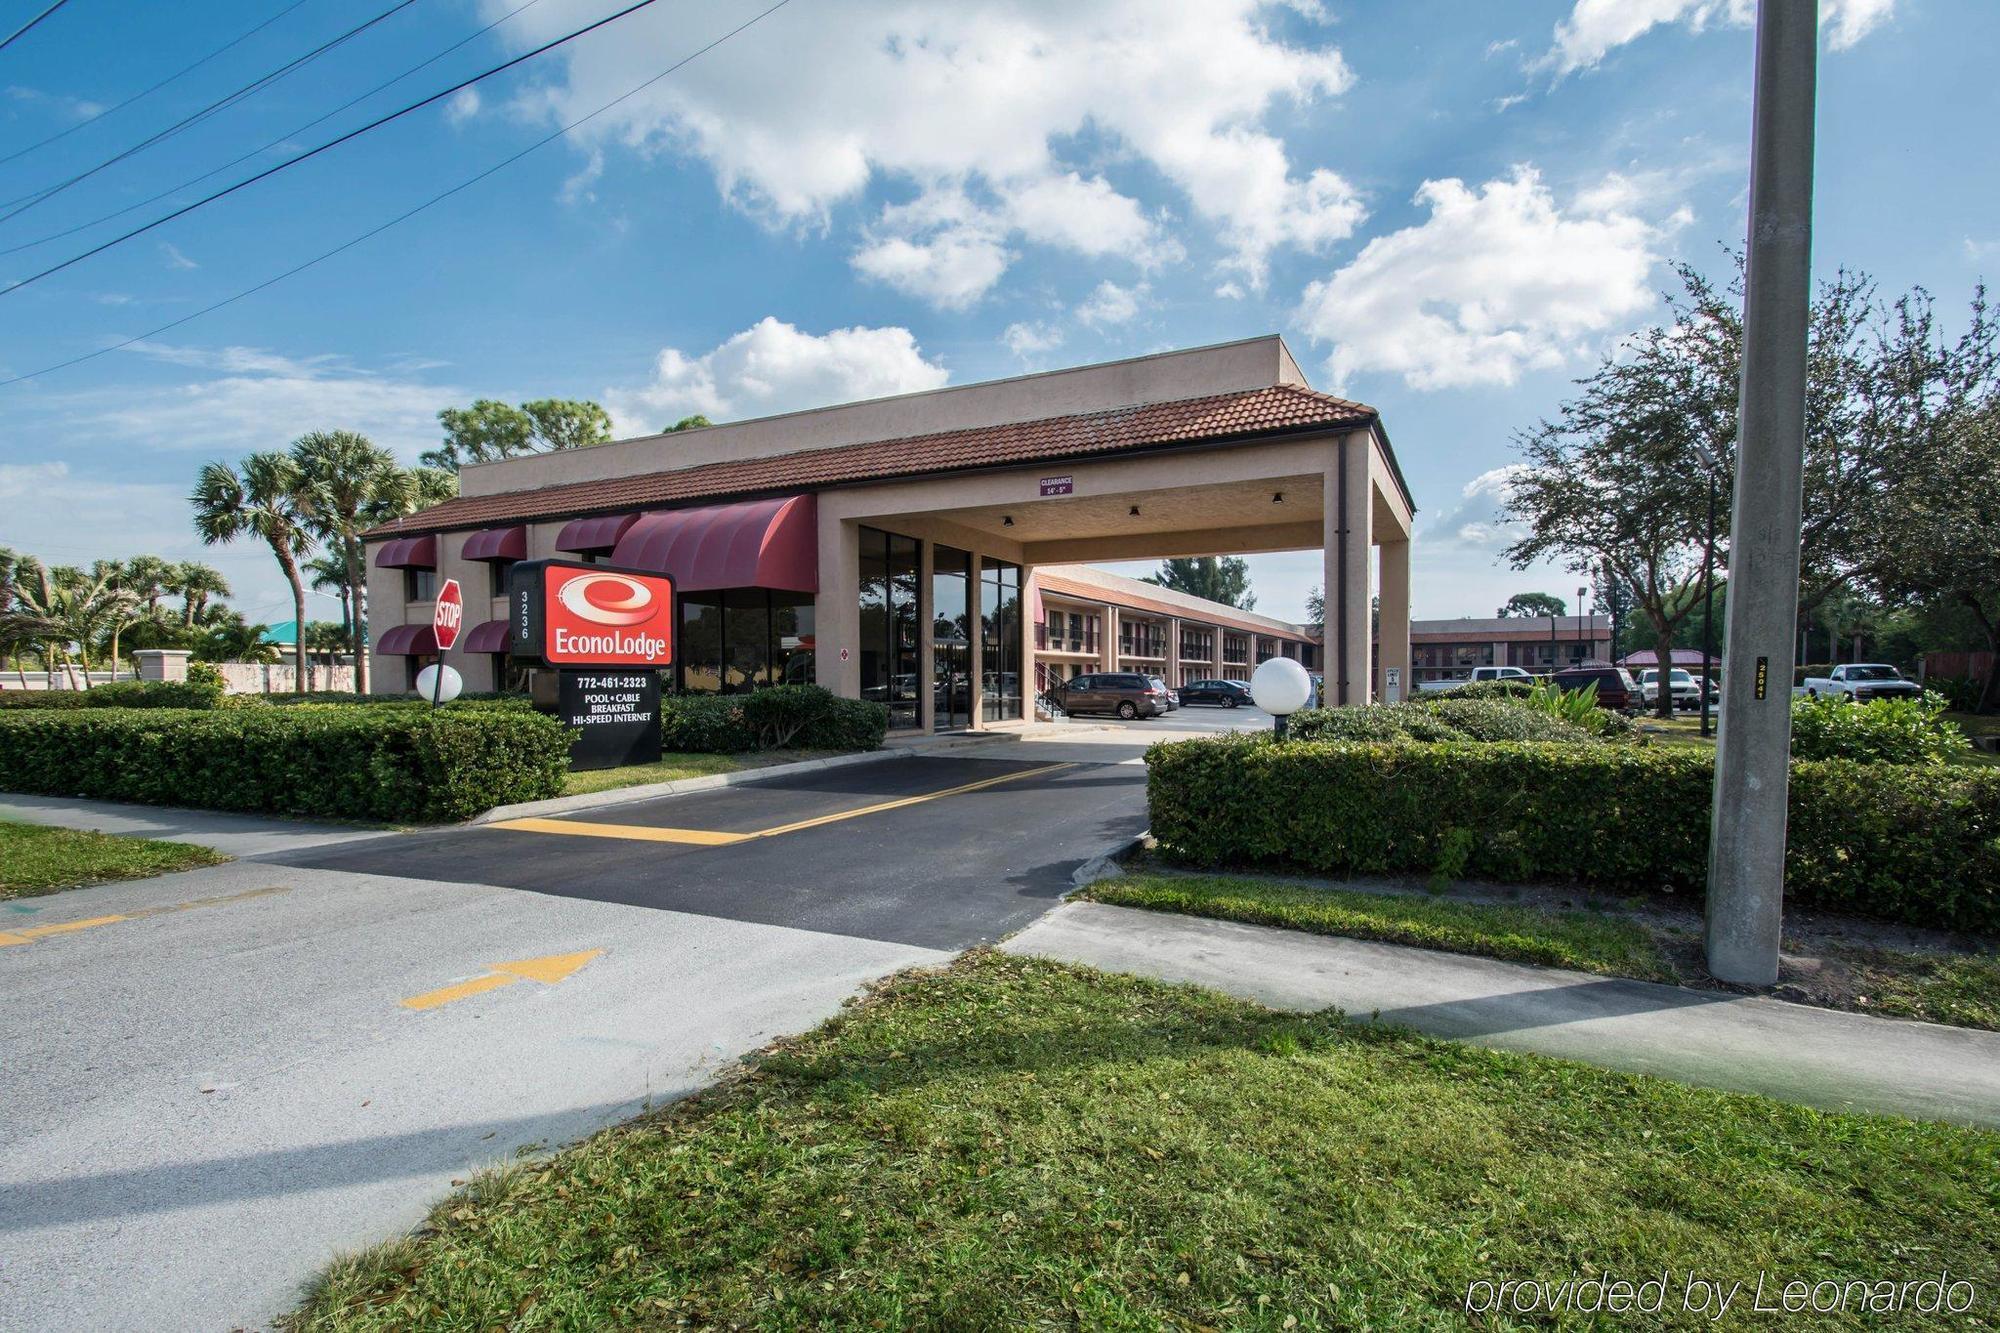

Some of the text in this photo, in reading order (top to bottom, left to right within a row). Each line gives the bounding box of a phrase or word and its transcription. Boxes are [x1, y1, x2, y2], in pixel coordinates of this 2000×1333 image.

[1041, 477, 1072, 486] CLEARANCE
[437, 601, 461, 628] STOP
[521, 591, 529, 639] 3236
[555, 628, 666, 661] EconoLodge
[577, 677, 647, 688] 772-461-2323
[585, 693, 640, 703] POOL CABLE
[591, 703, 636, 713] BREAKFAST
[573, 712, 652, 725] HI-SPEED INTERNET
